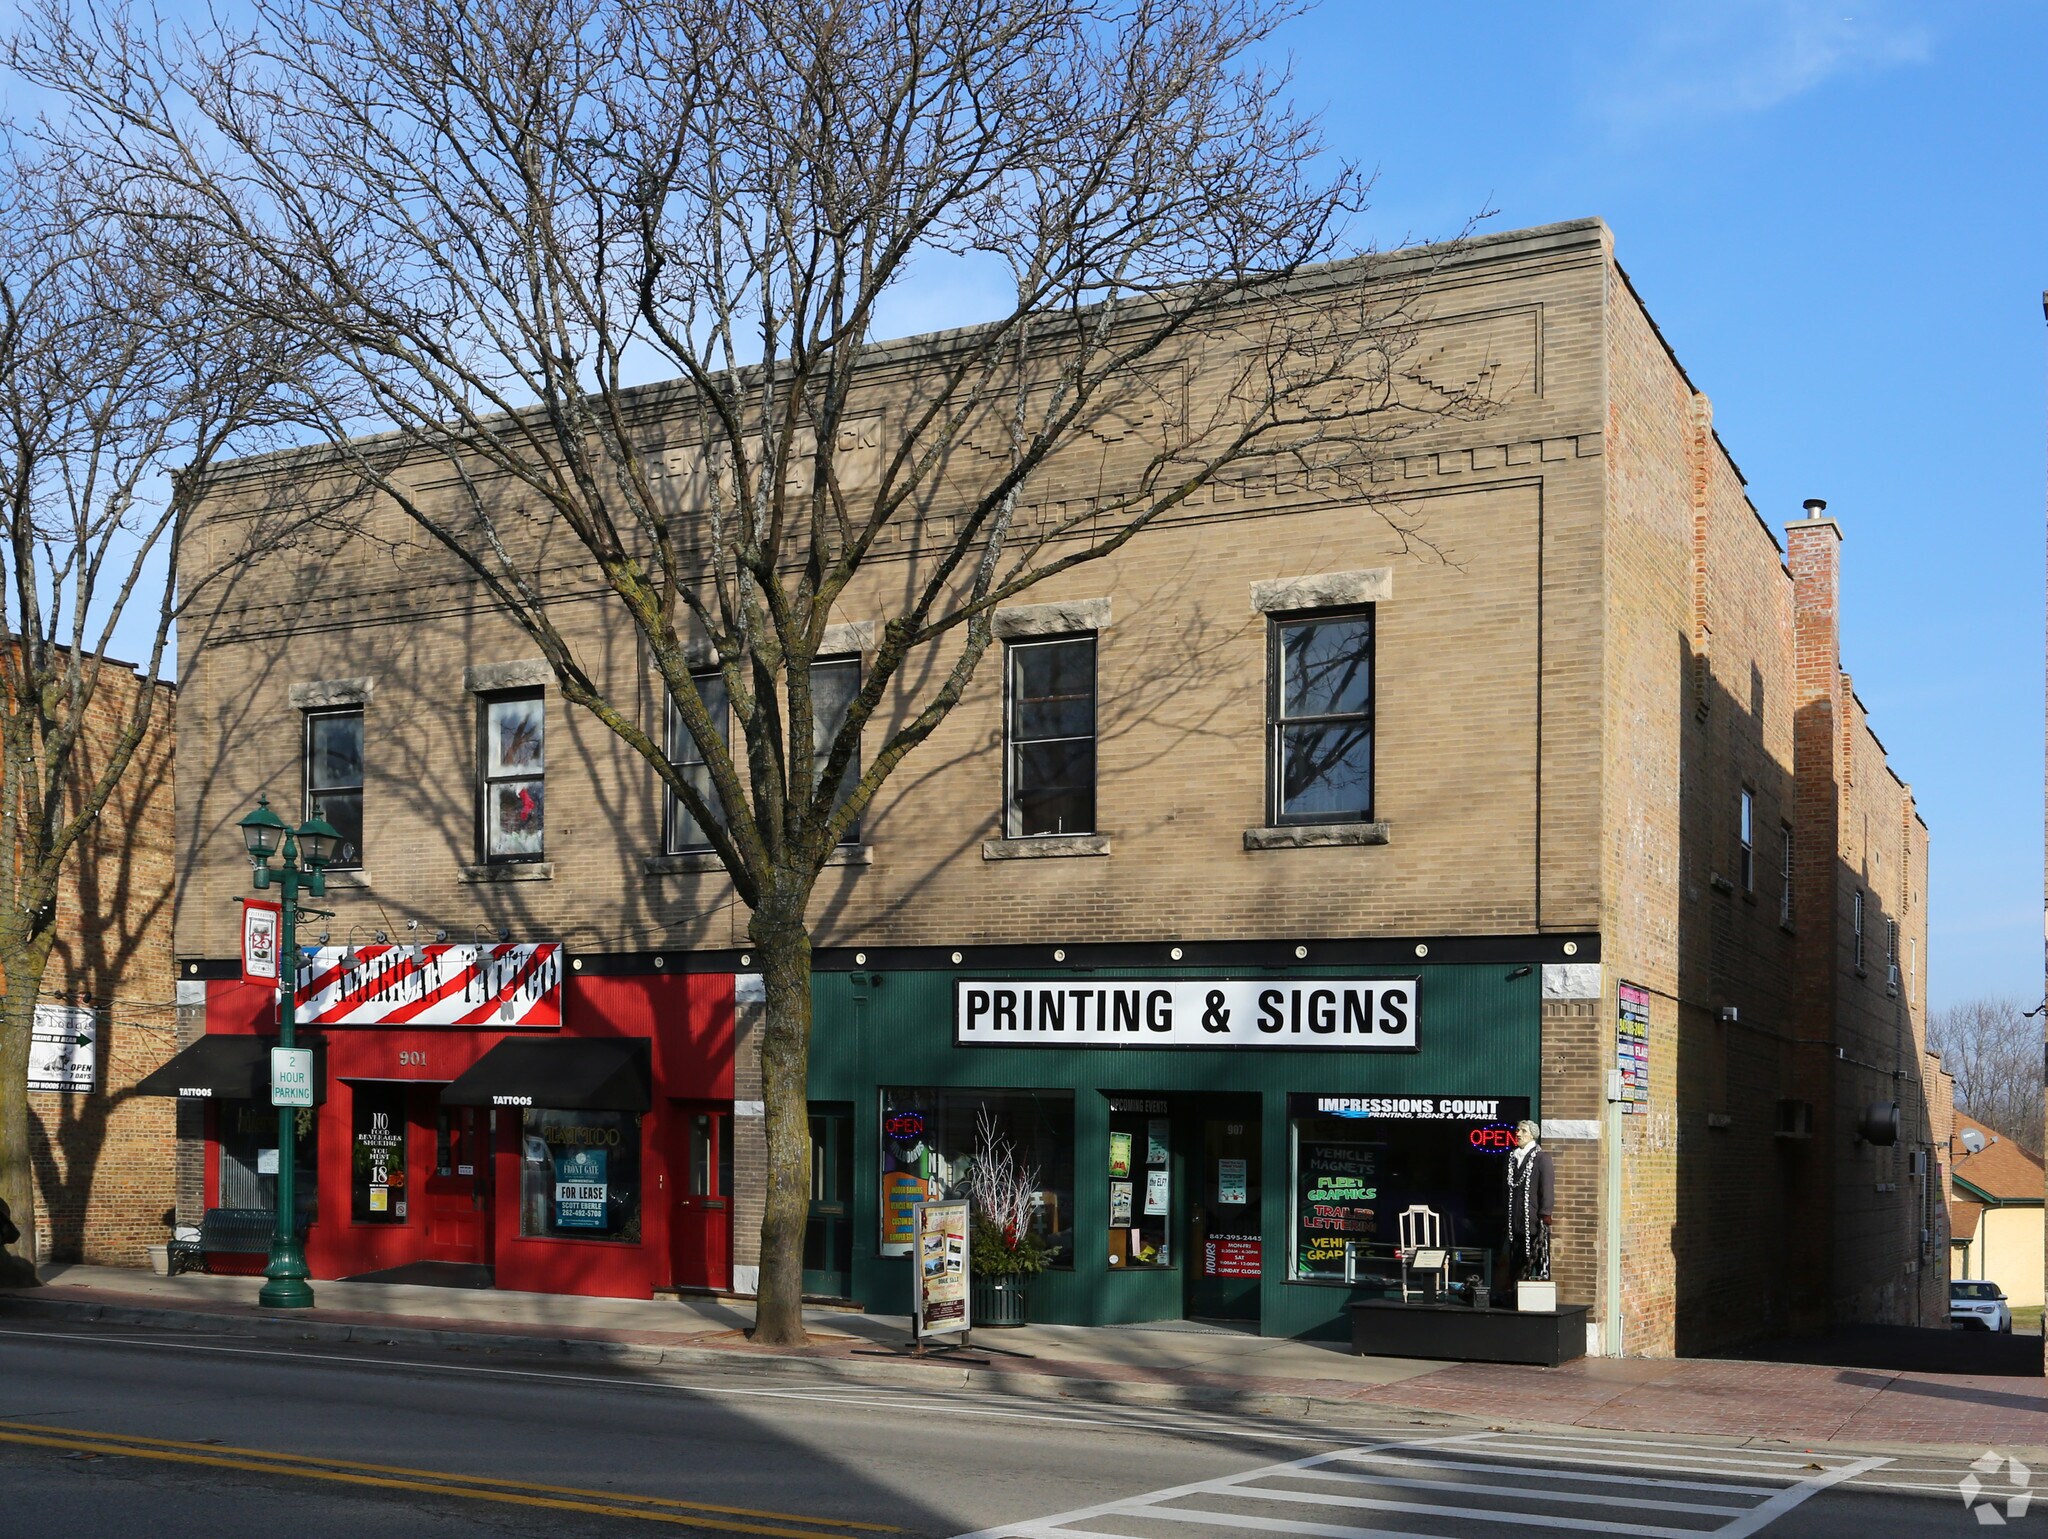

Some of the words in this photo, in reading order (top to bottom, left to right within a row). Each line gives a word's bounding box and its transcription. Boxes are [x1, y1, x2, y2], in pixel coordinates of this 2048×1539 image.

[251, 932, 273, 950] 125
[966, 989, 1173, 1032] PRINTING
[1201, 989, 1231, 1033] &
[1257, 988, 1408, 1034] SIGNS
[289, 1056, 296, 1067] 2
[399, 1051, 427, 1067] 901
[70, 1063, 92, 1072] OPEN
[280, 1072, 305, 1083] HOUR
[40, 1081, 60, 1090] WOODS
[179, 1087, 212, 1097] TATTOOS
[275, 1087, 310, 1099] PARKING
[493, 1096, 532, 1106] TATTOOS
[1110, 1098, 1144, 1112] UPCOMING
[1145, 1100, 1168, 1114] EVENTS
[1318, 1098, 1434, 1113] IMPRESSIONS
[1439, 1100, 1499, 1114] COUNT
[373, 1112, 389, 1130] NO
[1368, 1112, 1415, 1120] PRINTING,
[886, 1118, 924, 1133] OPEN
[1227, 1124, 1244, 1135] 907
[545, 1126, 621, 1147] TATTOO
[1470, 1129, 1518, 1147] OPEN
[1315, 1146, 1374, 1162] VEHICLE
[563, 1164, 584, 1174] FRONT
[584, 1165, 599, 1175] GATE
[1310, 1158, 1376, 1175] MAGNETS
[371, 1166, 388, 1183] 18
[1317, 1177, 1364, 1189] FLEET
[561, 1186, 576, 1199] FOR
[579, 1187, 603, 1200] LEASE
[1307, 1188, 1377, 1201] GRAPHICS
[1314, 1204, 1375, 1219] TRAILER
[1209, 1233, 1262, 1241] 847-395-2445
[1205, 1242, 1216, 1274] HOURS
[1306, 1250, 1375, 1260] GRAPCS
